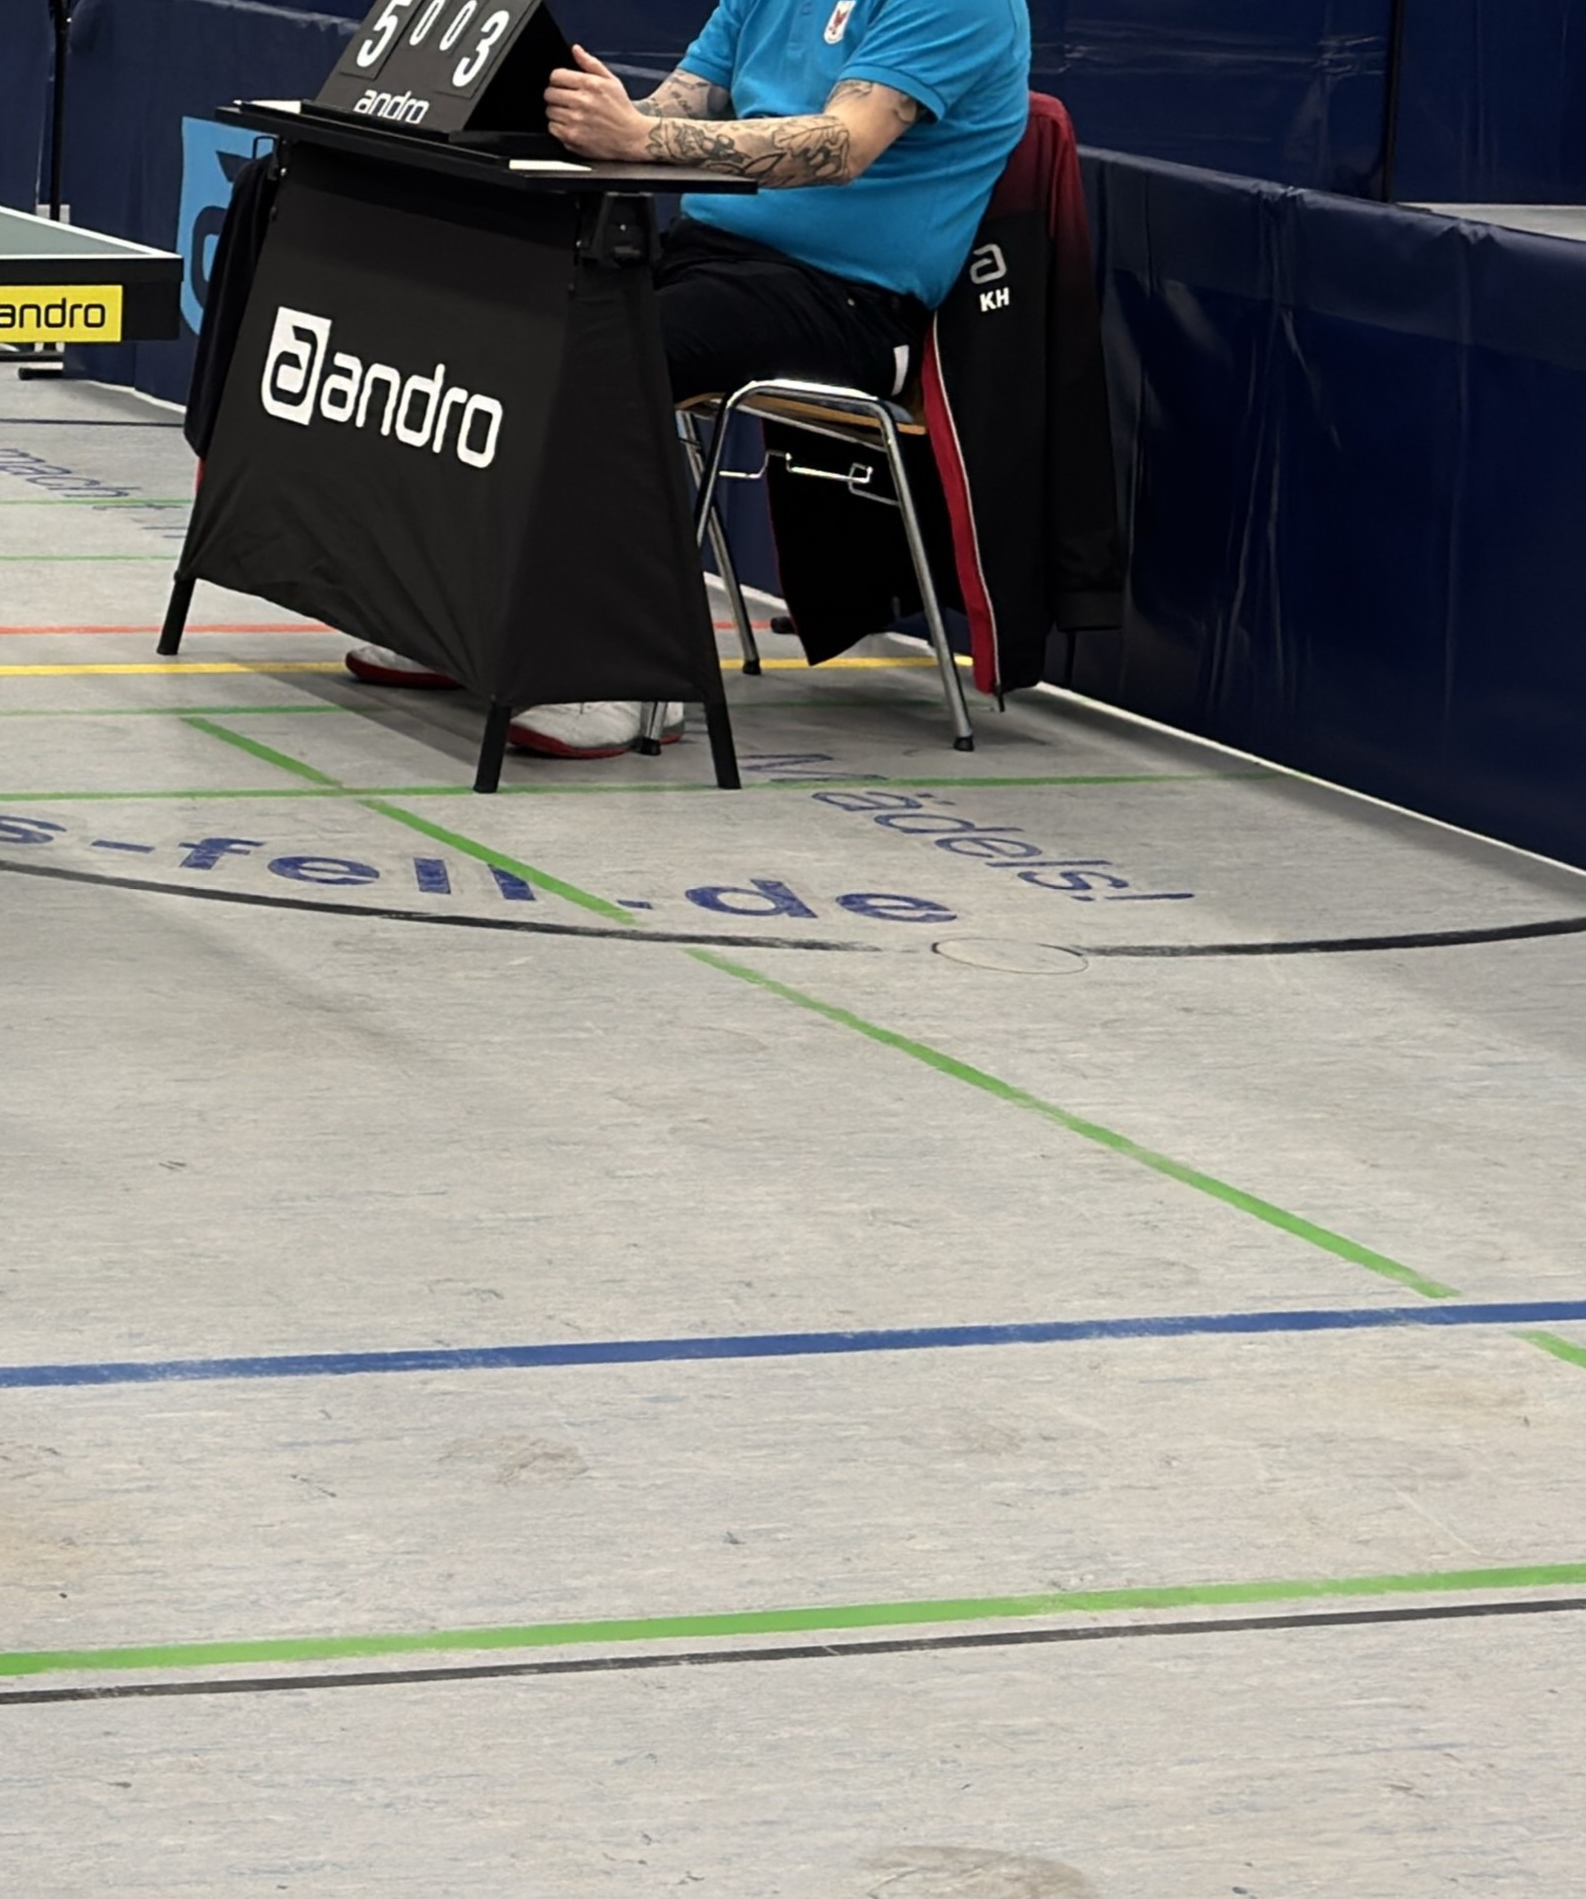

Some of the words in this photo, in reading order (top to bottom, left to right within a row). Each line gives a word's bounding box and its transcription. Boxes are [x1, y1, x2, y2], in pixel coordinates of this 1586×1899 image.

[439, 0, 478, 51] 0
[452, 9, 510, 88] 3
[353, 89, 430, 125] andro
[979, 286, 1010, 312] KH
[320, 352, 504, 469] andro
